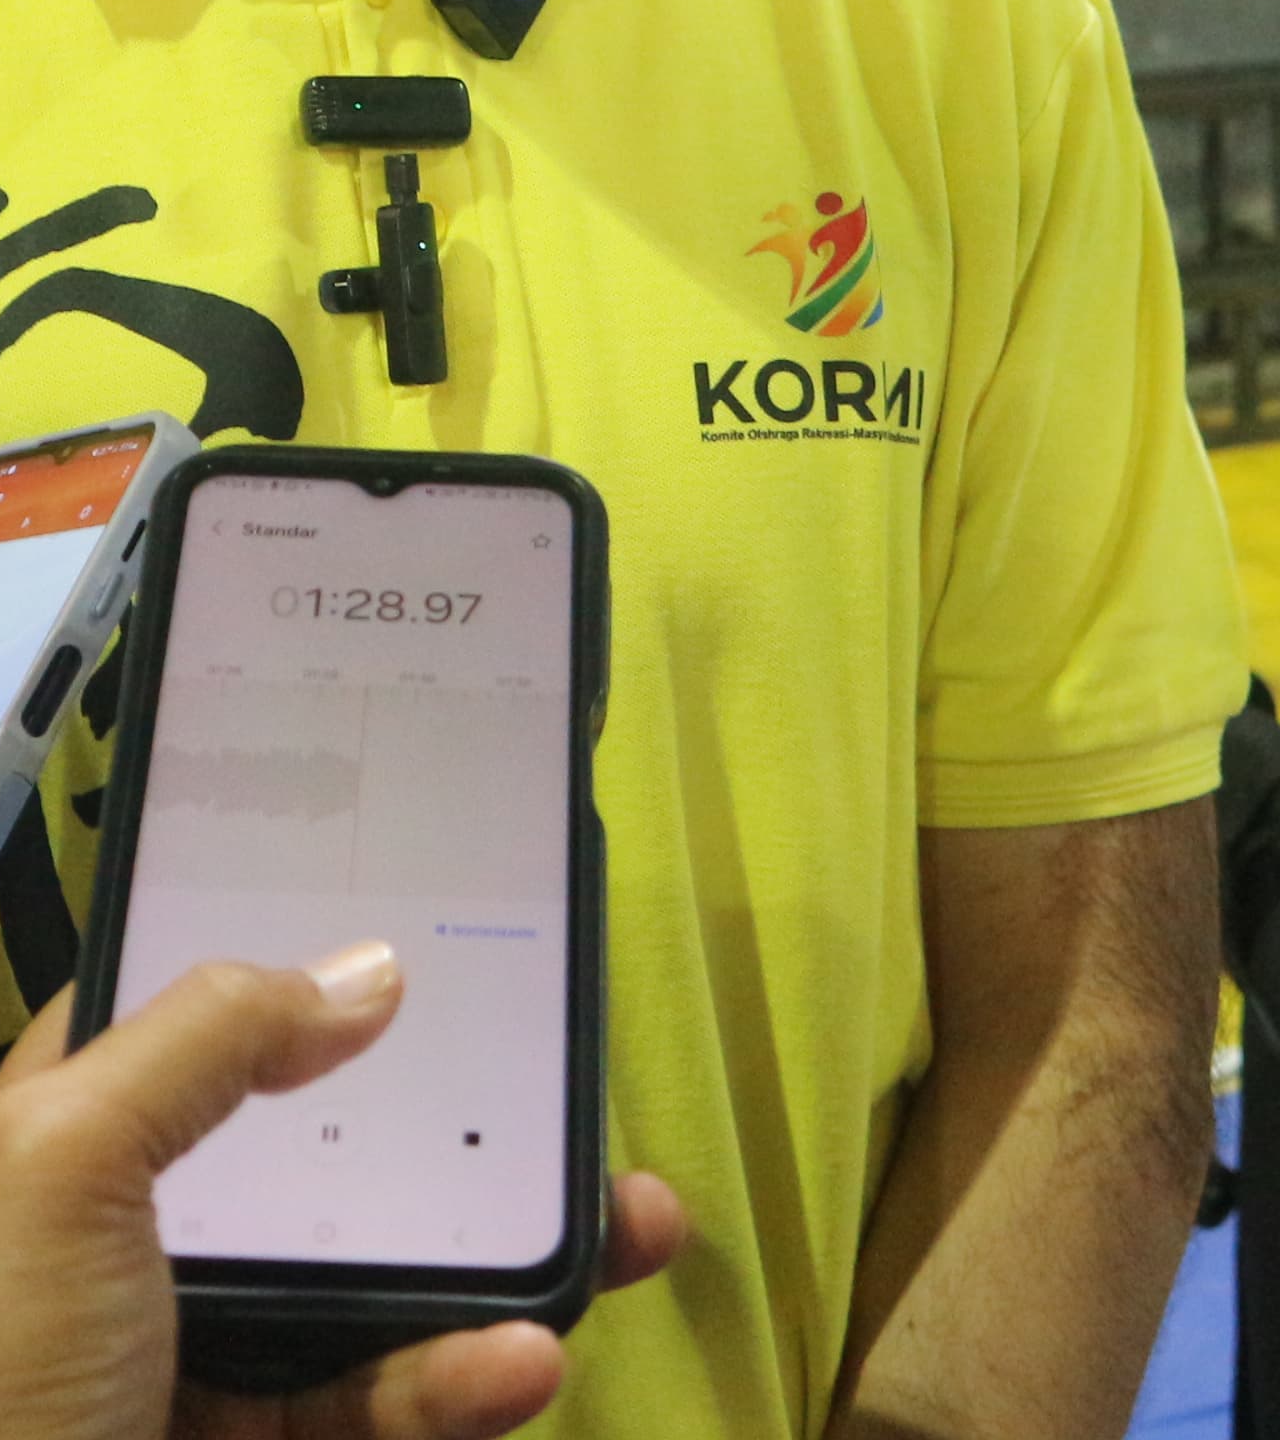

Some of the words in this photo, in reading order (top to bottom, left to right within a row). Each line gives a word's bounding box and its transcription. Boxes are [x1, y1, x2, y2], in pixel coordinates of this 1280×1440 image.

[693, 359, 925, 430] KORMI
[242, 521, 319, 539] Standar
[269, 584, 483, 625] 01:28.97
